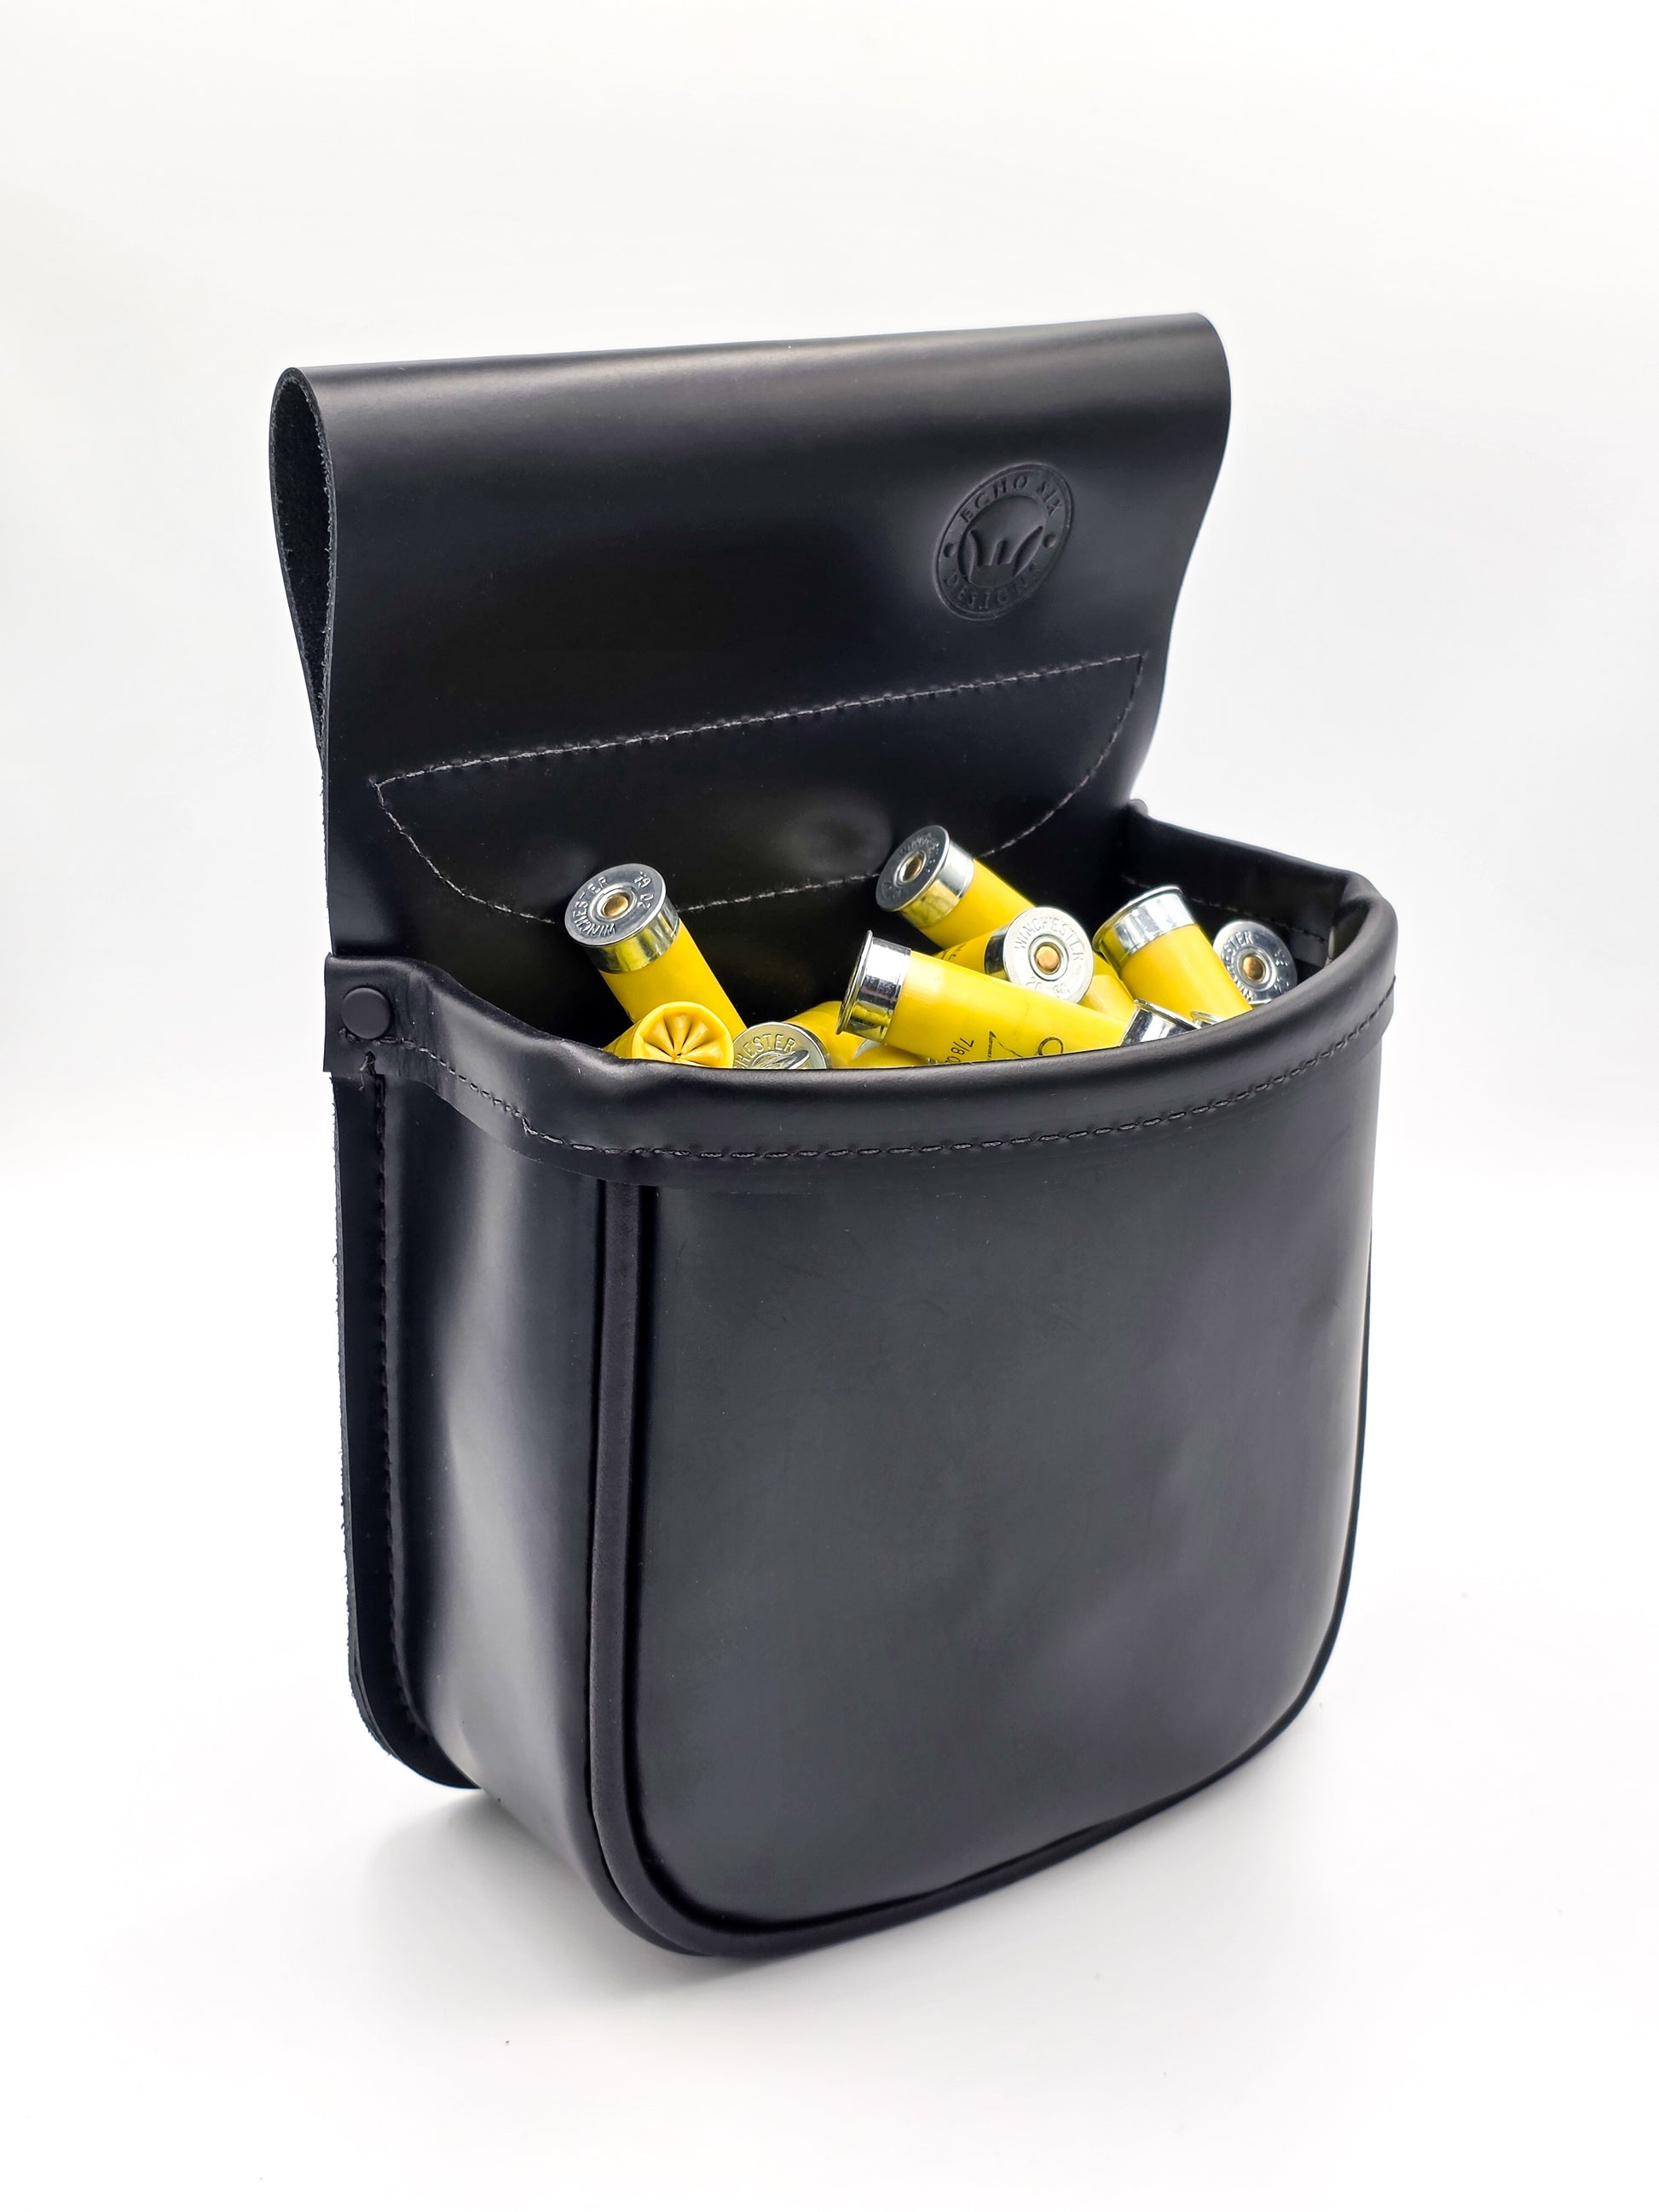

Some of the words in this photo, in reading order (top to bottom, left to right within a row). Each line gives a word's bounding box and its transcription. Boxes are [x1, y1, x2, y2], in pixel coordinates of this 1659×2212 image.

[960, 475, 1028, 523] ECHO
[1036, 481, 1063, 517] SIX
[572, 876, 616, 937] WINCHESTER
[1014, 915, 1085, 962] WINCHESTER
[733, 1033, 796, 1068] HESTER
[951, 1037, 974, 1055] 7/8
